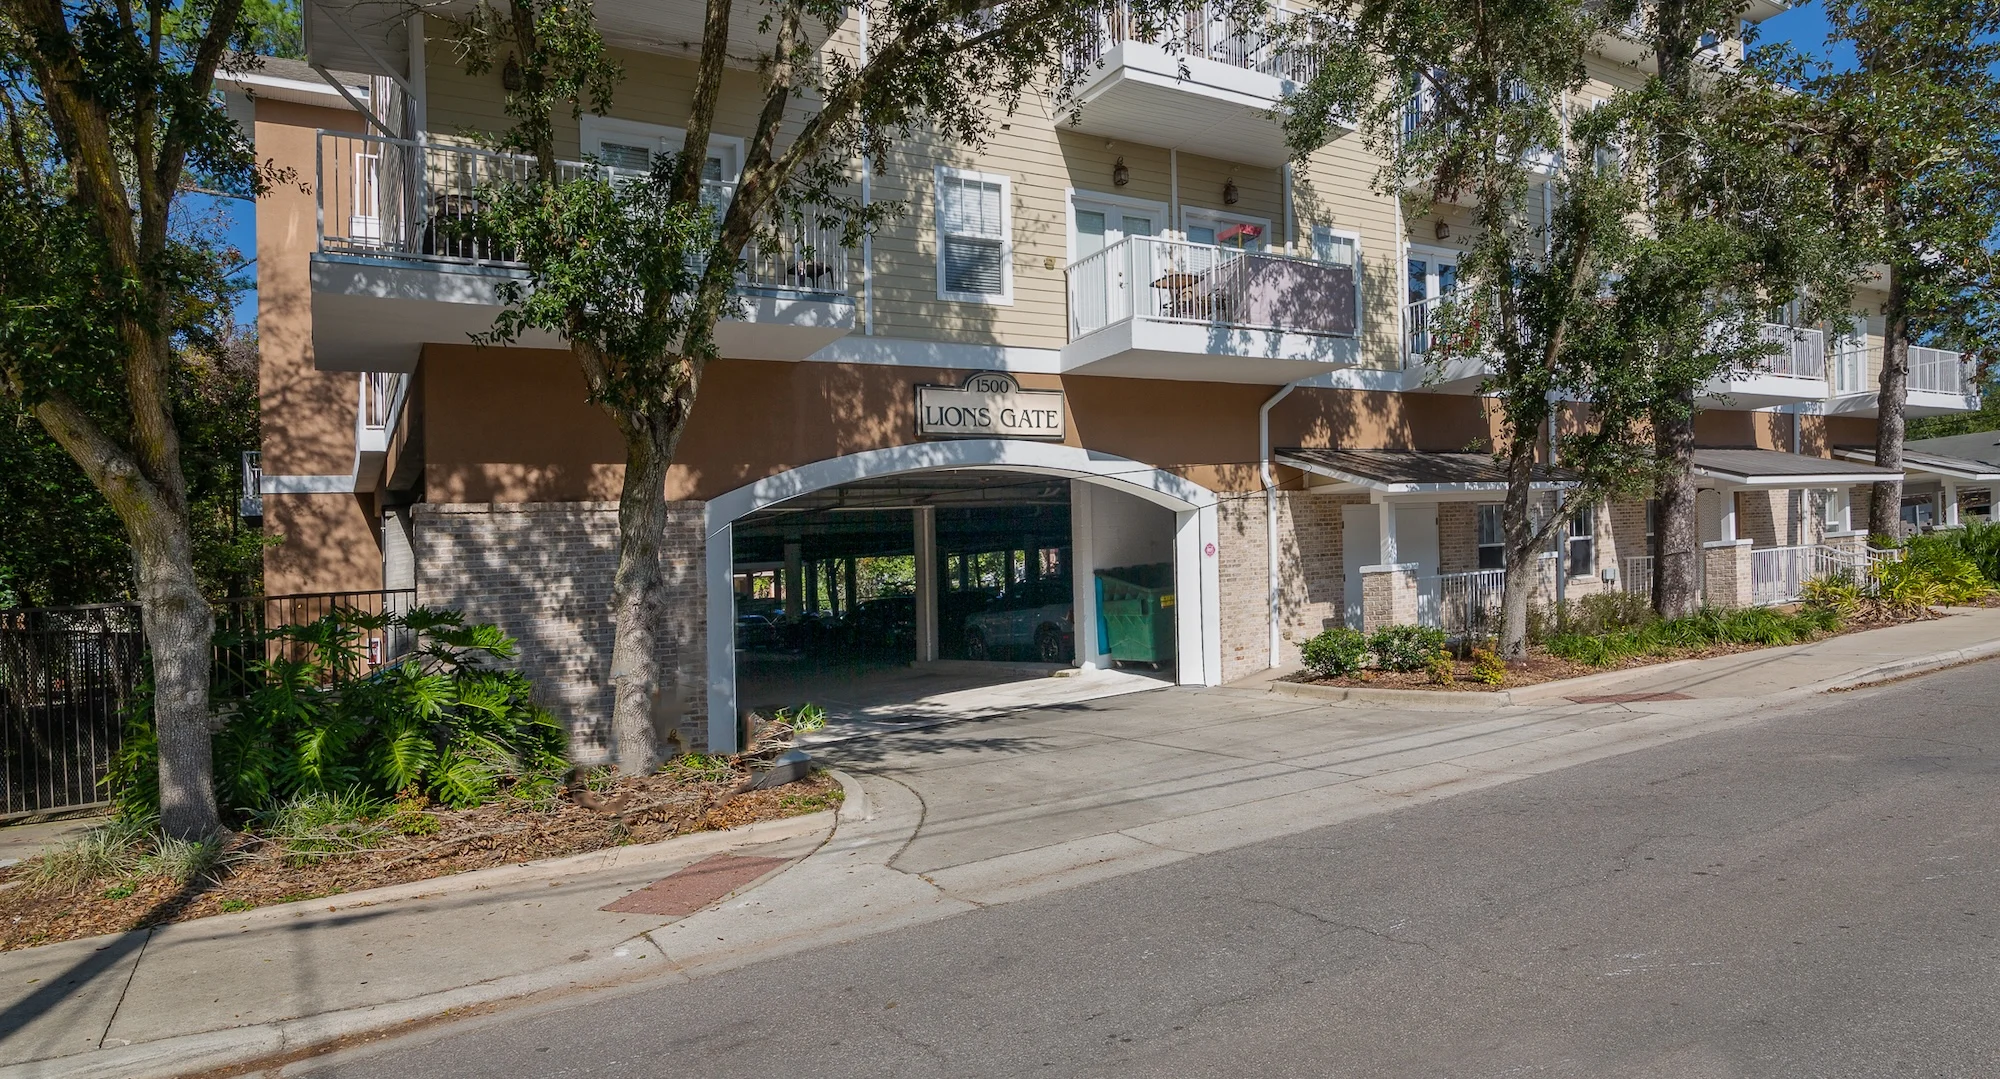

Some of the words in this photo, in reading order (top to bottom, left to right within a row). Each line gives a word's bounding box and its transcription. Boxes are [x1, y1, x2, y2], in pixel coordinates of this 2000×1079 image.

[975, 379, 1009, 393] 1500
[925, 405, 991, 427] LIONS
[1000, 408, 1059, 428] GATE
